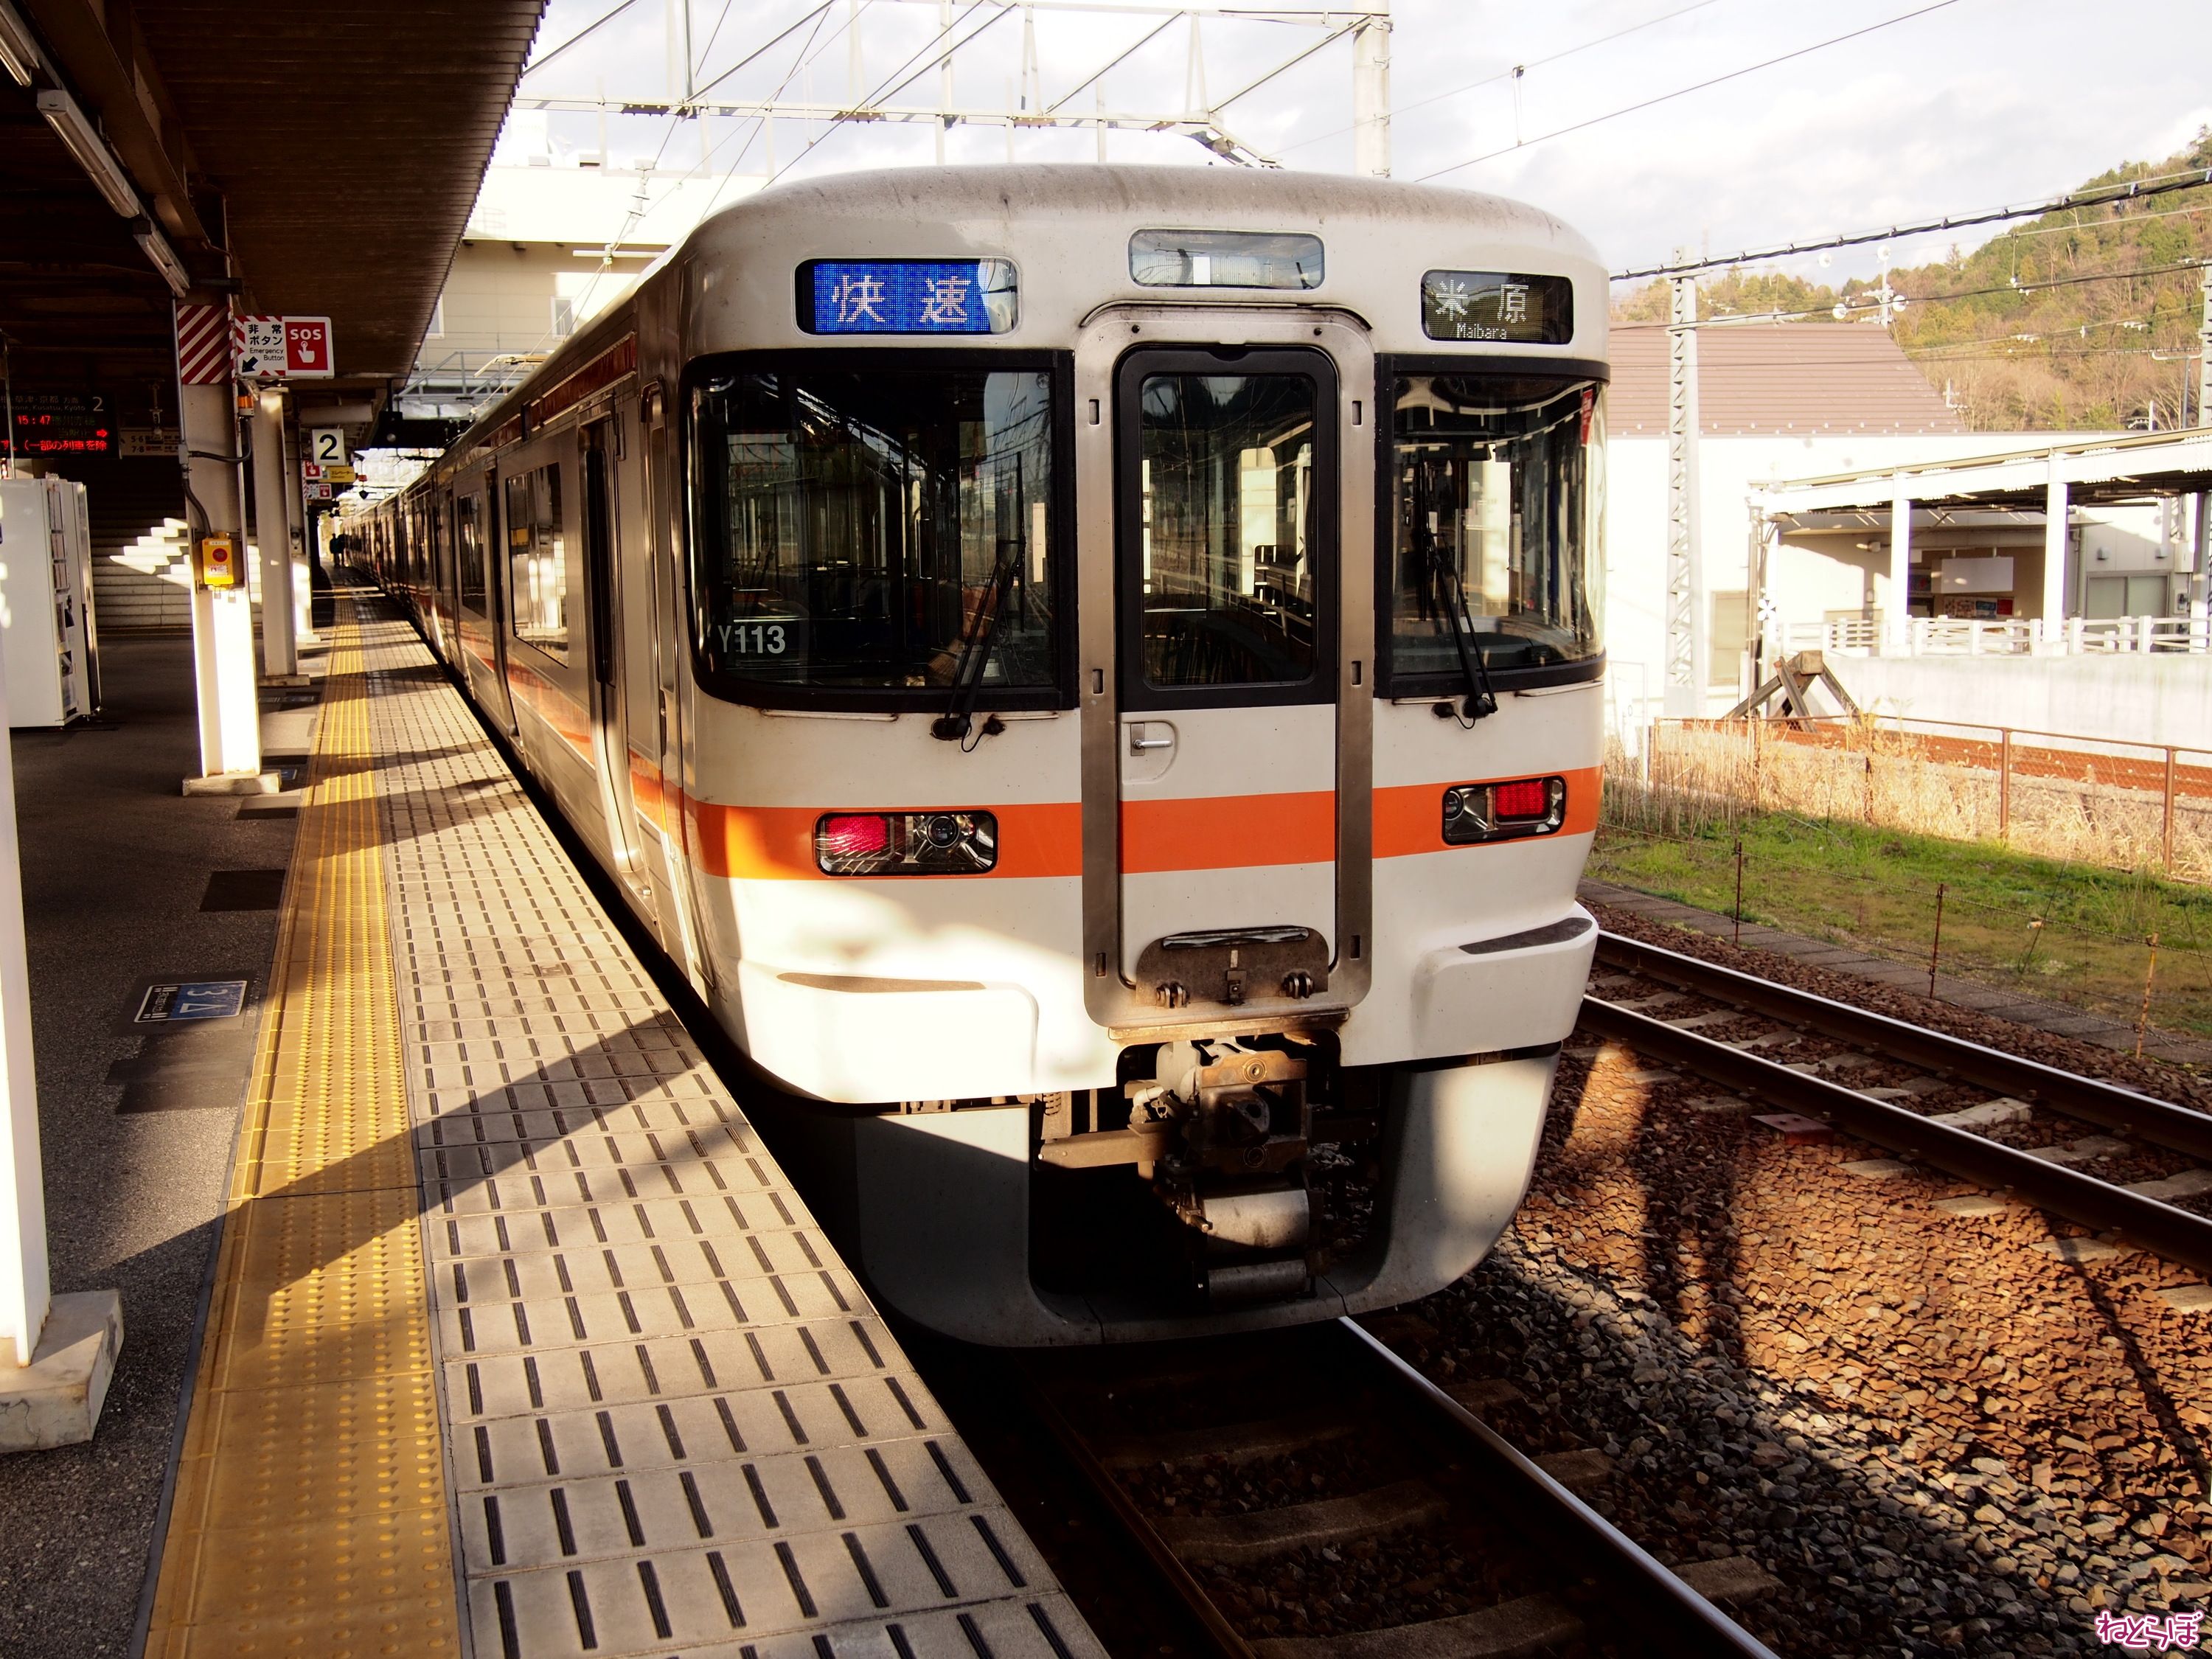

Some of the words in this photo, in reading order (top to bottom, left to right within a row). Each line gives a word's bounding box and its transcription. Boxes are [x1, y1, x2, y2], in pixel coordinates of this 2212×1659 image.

[832, 274, 972, 324] 快速
[1434, 279, 1529, 324] 米原
[248, 324, 282, 334] 非常
[290, 329, 322, 341] SOS
[1455, 322, 1508, 341] Maibara
[249, 336, 282, 346] ボタン
[92, 396, 105, 412] 2
[319, 434, 339, 460] 2
[718, 625, 786, 655] Y113
[187, 988, 228, 996] 3
